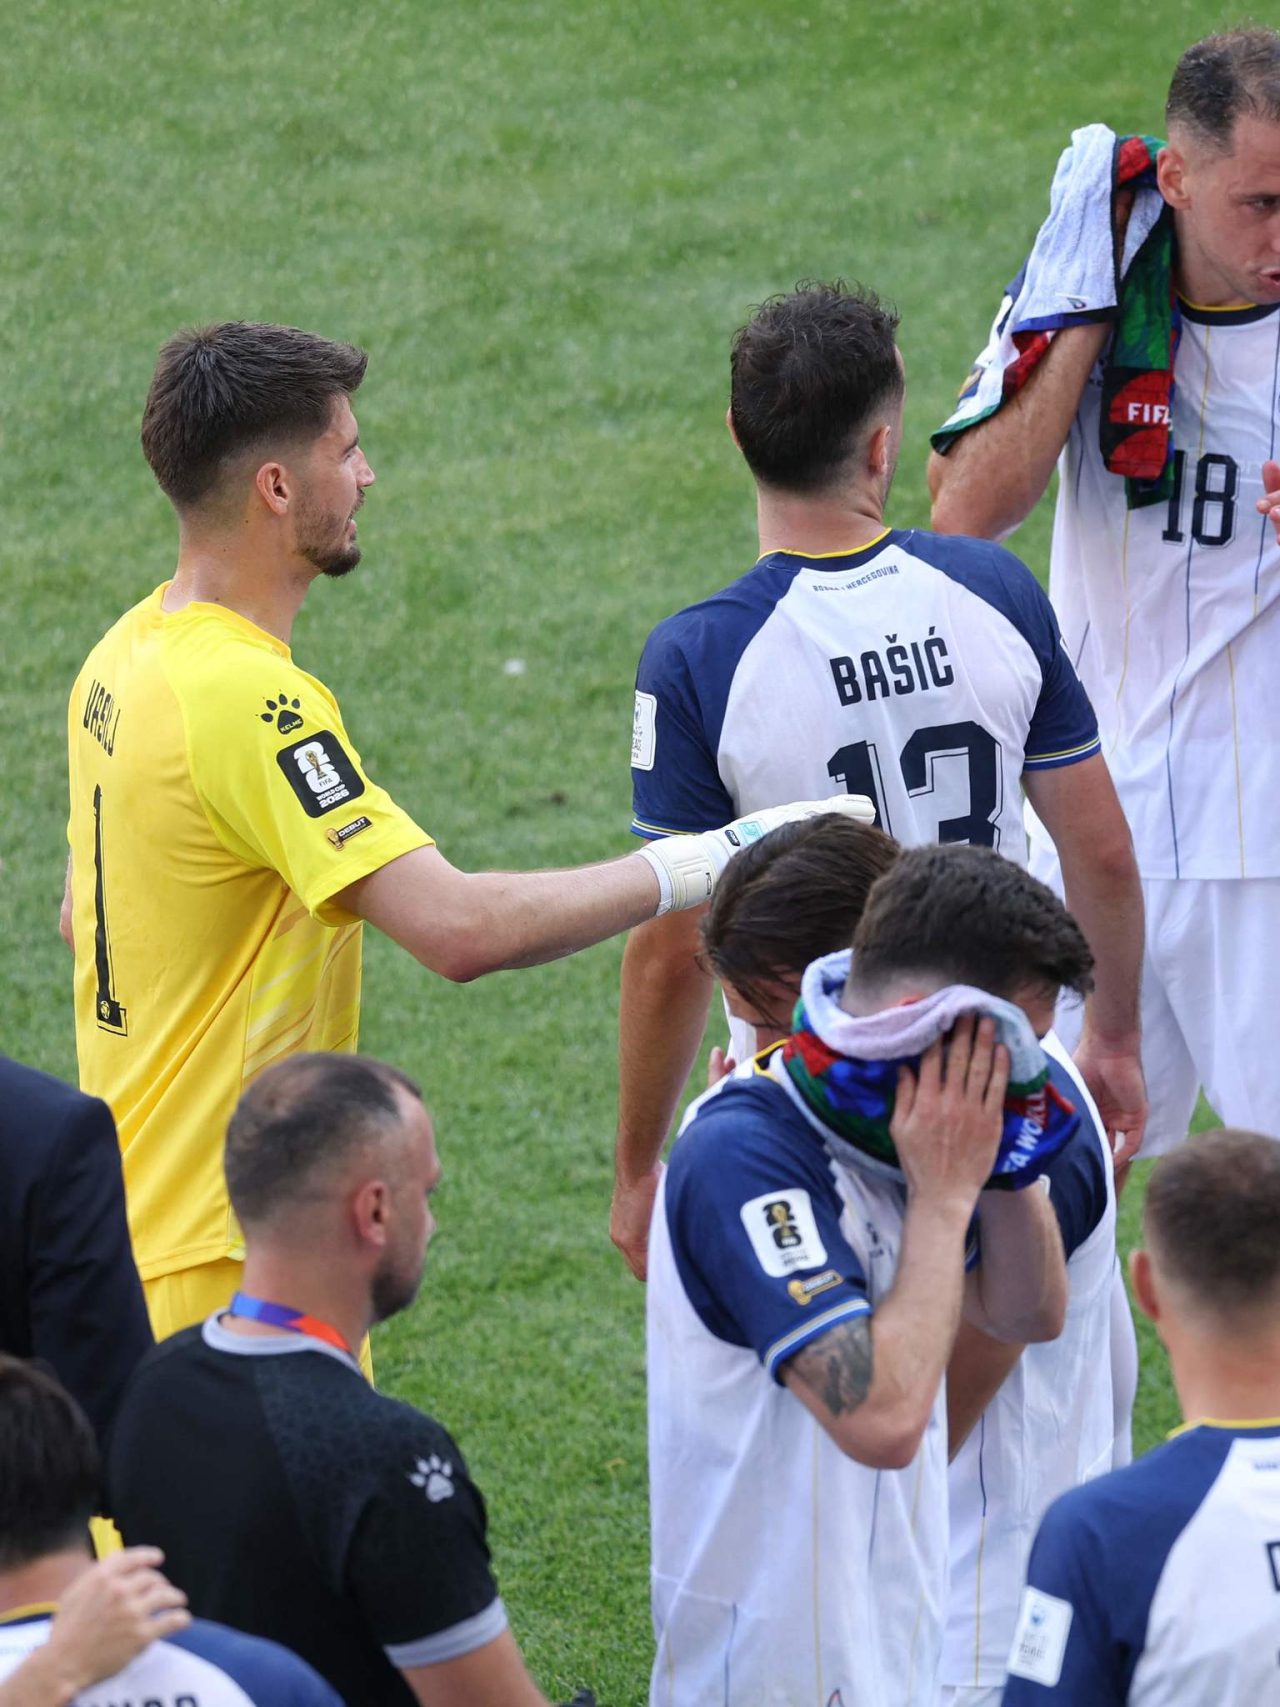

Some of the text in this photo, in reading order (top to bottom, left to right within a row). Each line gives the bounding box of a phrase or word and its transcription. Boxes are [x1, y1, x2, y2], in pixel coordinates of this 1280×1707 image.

[1162, 450, 1241, 549] 18
[829, 626, 955, 707] BAŠIĆ
[279, 718, 303, 733] KELME
[319, 789, 350, 809] 2026
[338, 817, 366, 838] DEBUT
